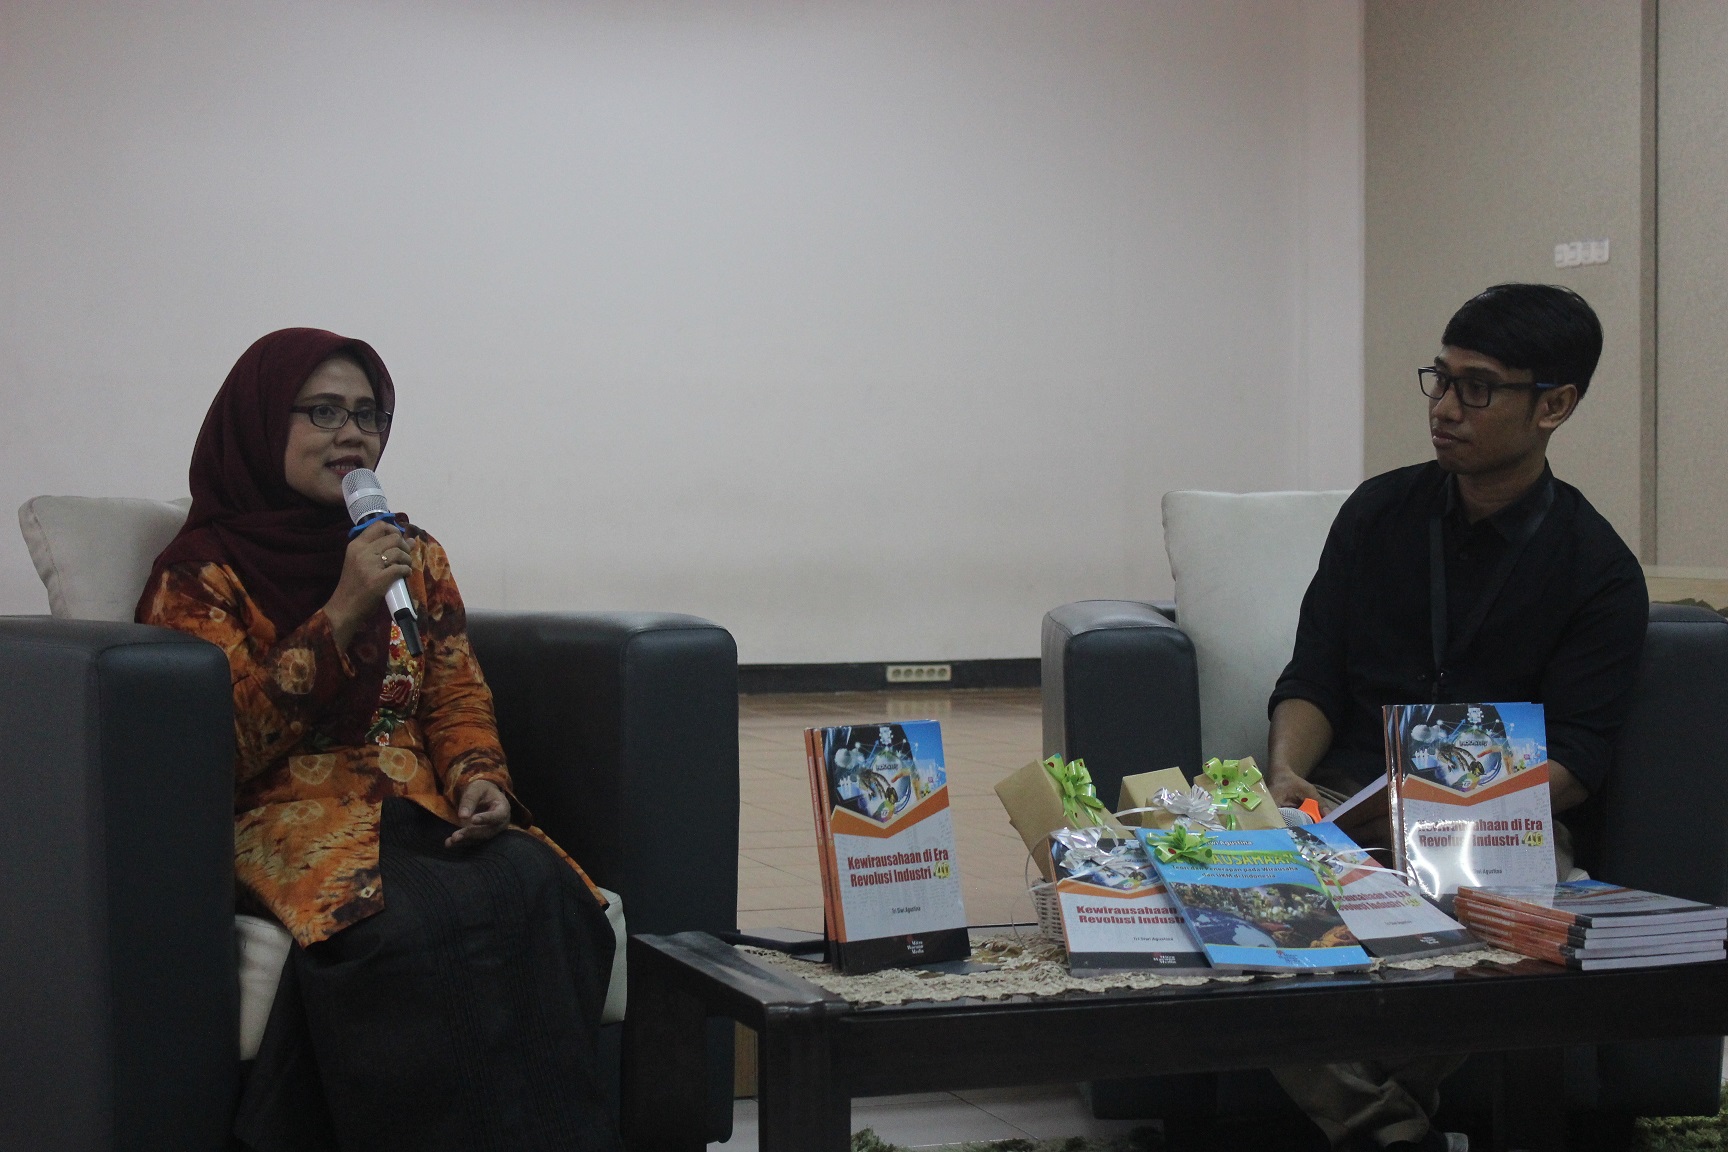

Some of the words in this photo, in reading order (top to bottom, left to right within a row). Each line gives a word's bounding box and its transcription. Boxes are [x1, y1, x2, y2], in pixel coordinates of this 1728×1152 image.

[1511, 819, 1523, 831] di
[1524, 818, 1543, 831] Era
[1472, 834, 1520, 847] Industri
[847, 851, 922, 871] Kewirausahaan
[923, 848, 933, 862] di
[933, 847, 949, 862] Era
[850, 868, 893, 888] Revolusi
[893, 866, 932, 883] Industri
[1076, 905, 1178, 915] Kewirausahaan
[1078, 915, 1136, 924] Revolusi
[1137, 915, 1185, 924] Industr
